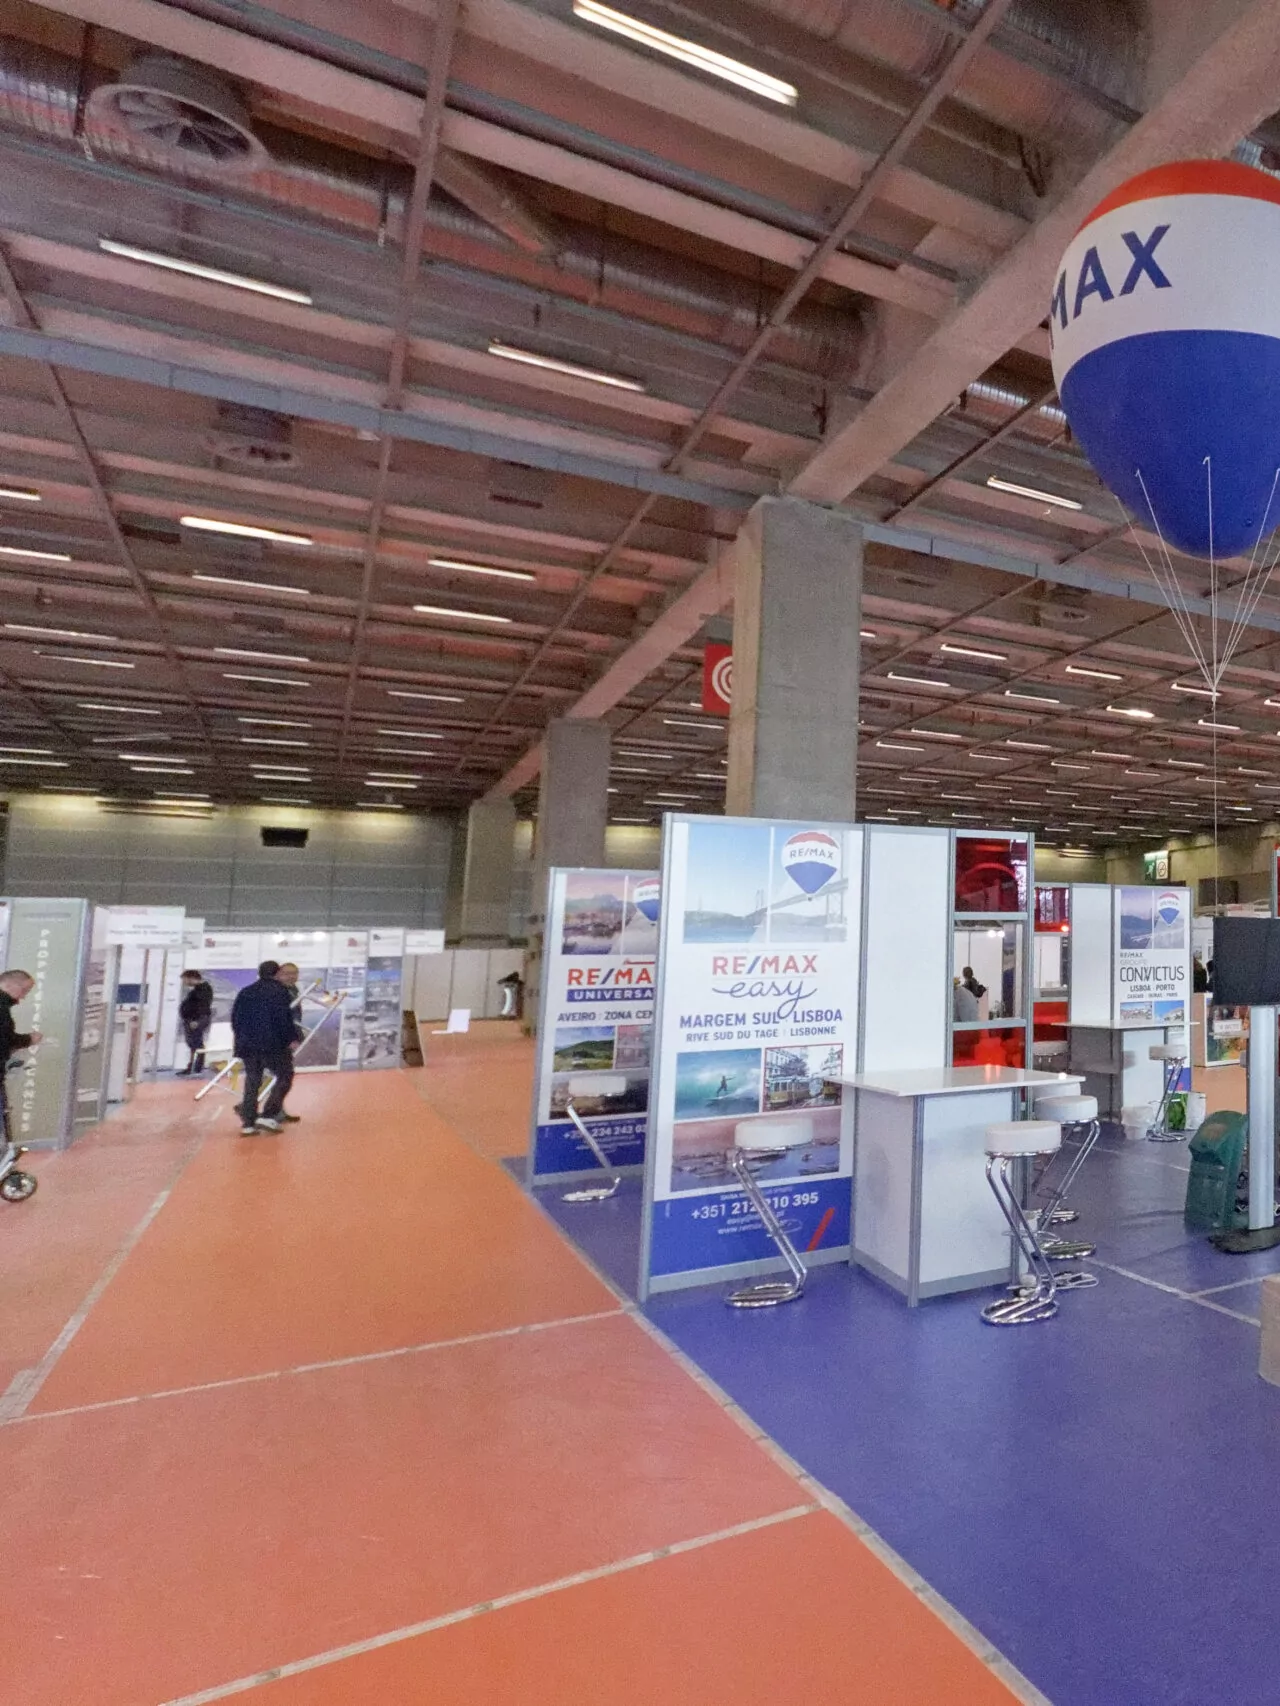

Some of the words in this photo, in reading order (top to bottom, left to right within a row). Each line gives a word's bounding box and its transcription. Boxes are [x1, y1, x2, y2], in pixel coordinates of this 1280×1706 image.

[789, 847, 834, 860] RE/MAX
[712, 954, 818, 976] RE/MAX
[568, 967, 653, 986] RE/MA
[1120, 966, 1185, 982] CONVICTUS
[574, 989, 653, 1001] UNIVERSA
[1130, 984, 1151, 993] LISBOA
[1156, 983, 1176, 992] PORTO
[712, 979, 818, 1020] easy
[557, 1013, 596, 1023] AVEIRO
[604, 1011, 632, 1021] ZONA
[635, 1009, 654, 1020] CEN
[680, 1012, 746, 1029] MARGEM
[753, 1011, 780, 1025] SUL
[793, 1008, 843, 1024] LISBOA
[686, 1032, 709, 1043] RIVE
[713, 1031, 733, 1041] SUD
[737, 1030, 751, 1040] DU
[755, 1029, 778, 1039] TAGE
[790, 1026, 837, 1038] LISBONNE
[691, 1204, 726, 1220] +351
[766, 1196, 789, 1210] 10
[792, 1192, 818, 1207] 395
